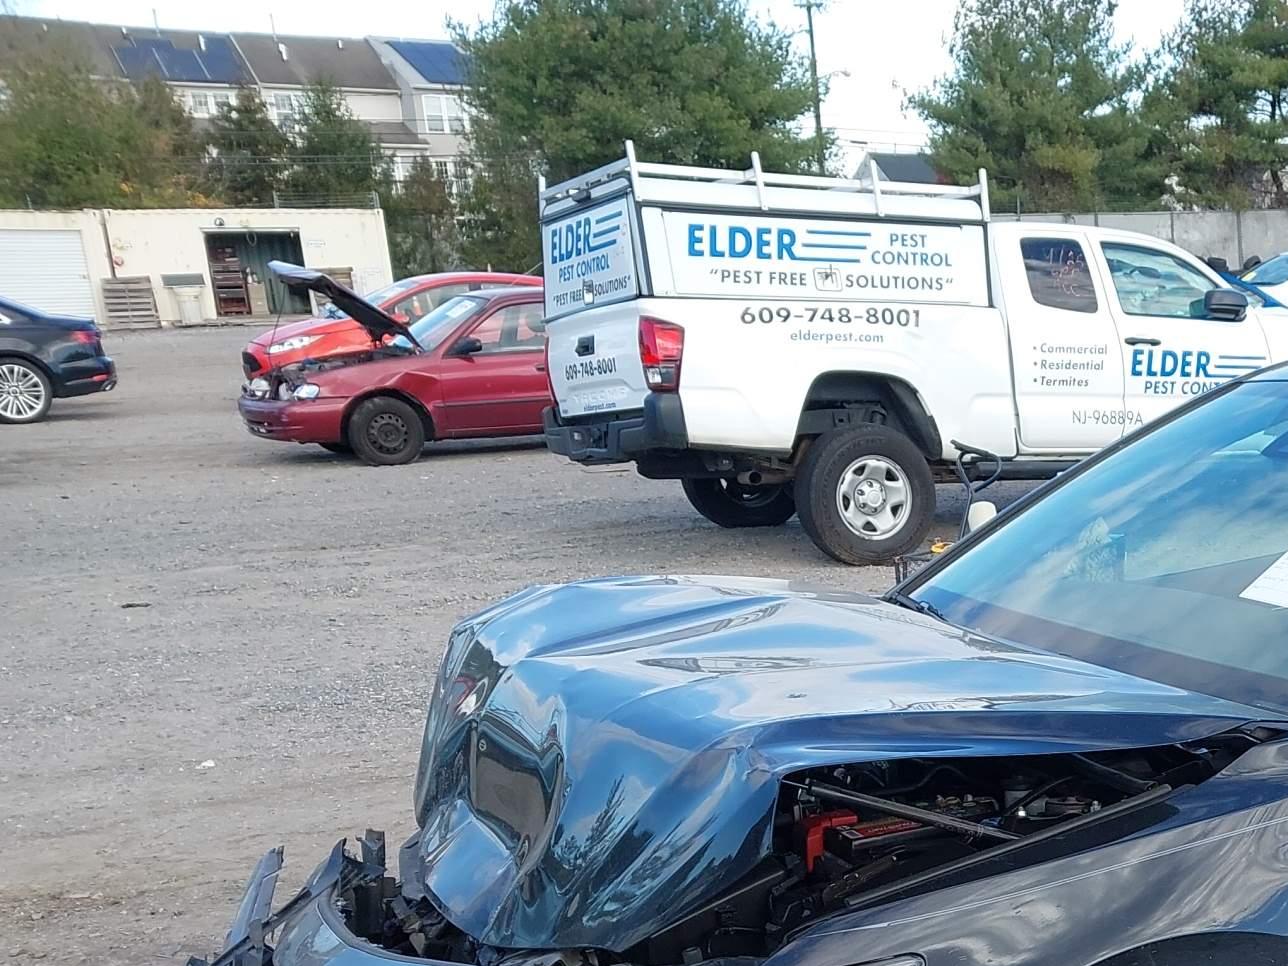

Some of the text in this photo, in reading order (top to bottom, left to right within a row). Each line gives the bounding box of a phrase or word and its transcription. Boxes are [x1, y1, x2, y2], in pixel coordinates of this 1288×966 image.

[551, 216, 591, 264] ELDER
[688, 224, 797, 260] ELDER
[889, 233, 927, 248] PEST
[871, 250, 952, 267] CONTROL
[558, 253, 609, 283] PEST CONTROL
[769, 271, 807, 286] FREE
[569, 289, 583, 304] FREE
[740, 307, 920, 328] 609-748-8001
[790, 330, 884, 343] elderpest.com
[1040, 343, 1108, 355] Commercial
[565, 357, 617, 380] 609-748-8001
[1040, 360, 1104, 371] Residential
[1131, 349, 1211, 378] ELDER
[1040, 376, 1089, 387] Termites
[1144, 381, 1176, 394] PEST
[1073, 410, 1144, 426] NJ-96889A
